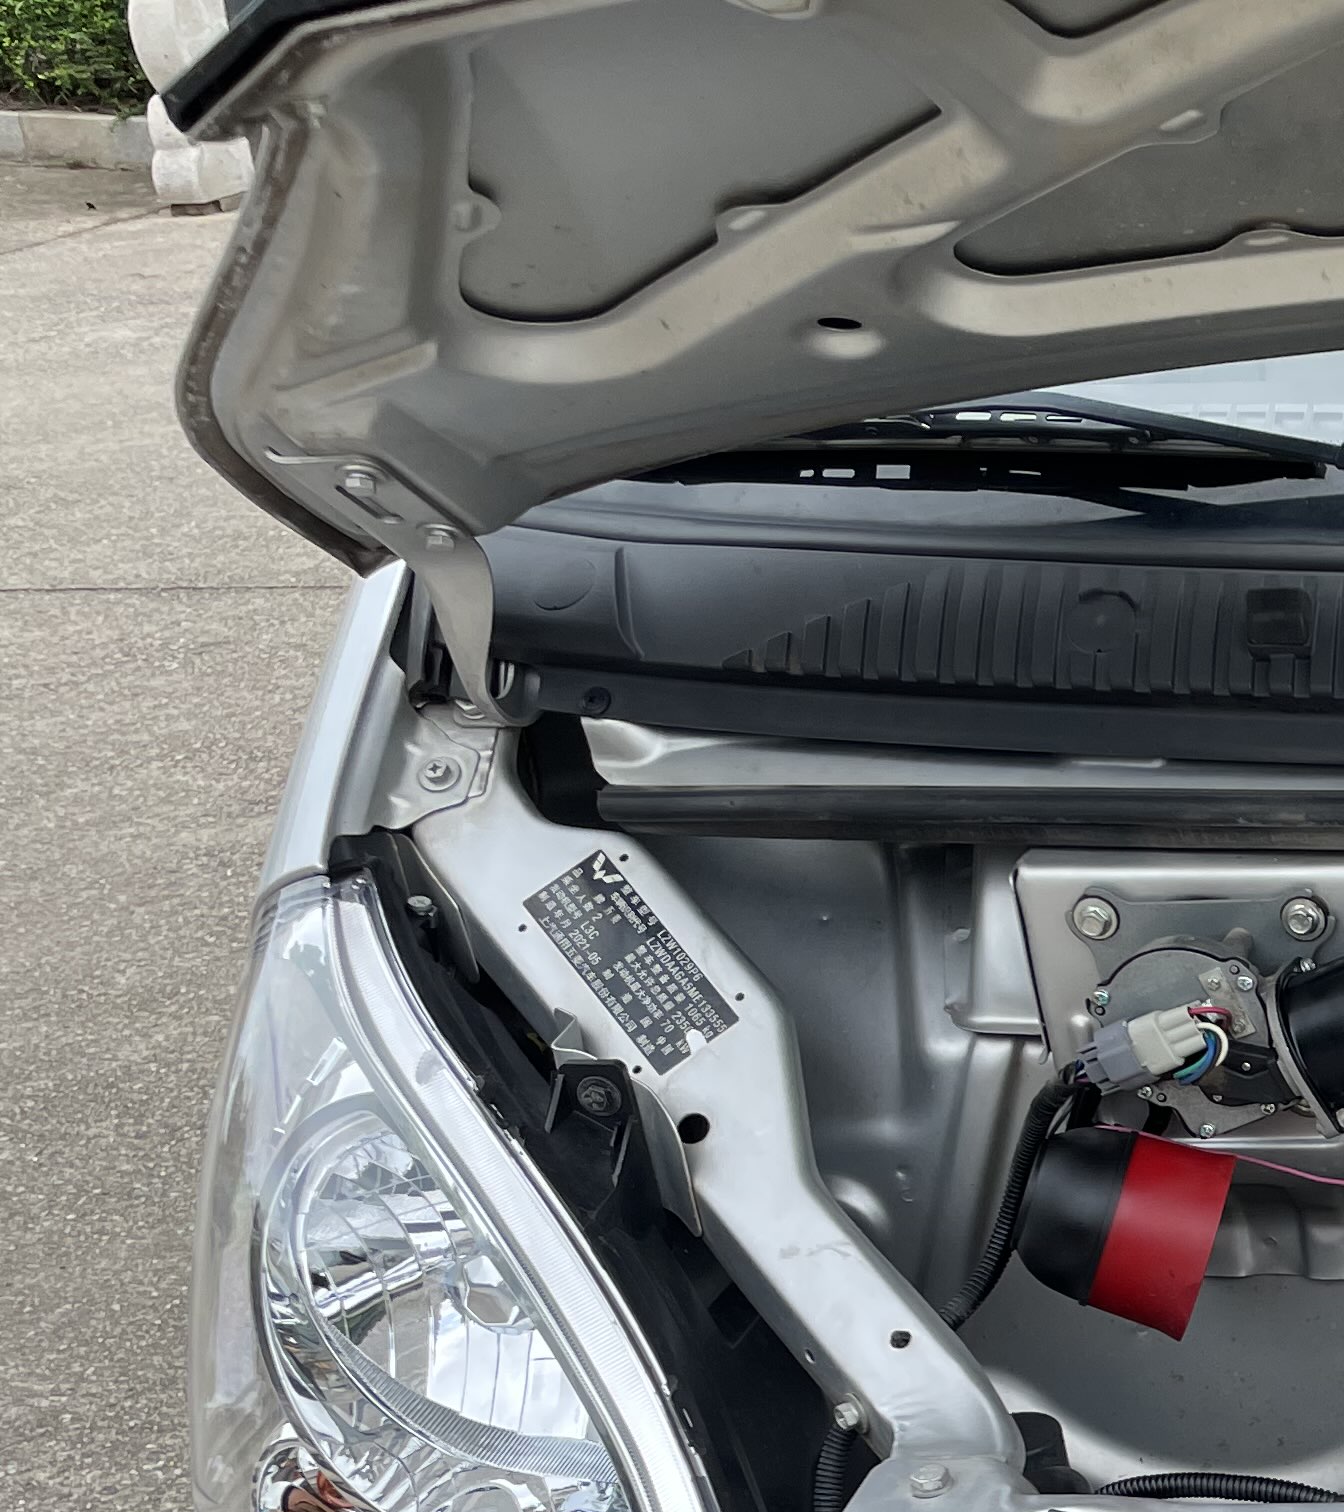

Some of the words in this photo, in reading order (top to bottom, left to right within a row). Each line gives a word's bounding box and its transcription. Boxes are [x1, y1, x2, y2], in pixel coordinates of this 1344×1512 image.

[578, 919, 601, 941] L3C
[590, 910, 604, 923] 2
[566, 927, 603, 967] 2021-05
[655, 927, 704, 983] LZW1029P6
[658, 1017, 676, 1035] 70
[681, 1001, 706, 1027] 1065
[699, 1023, 716, 1040] kg
